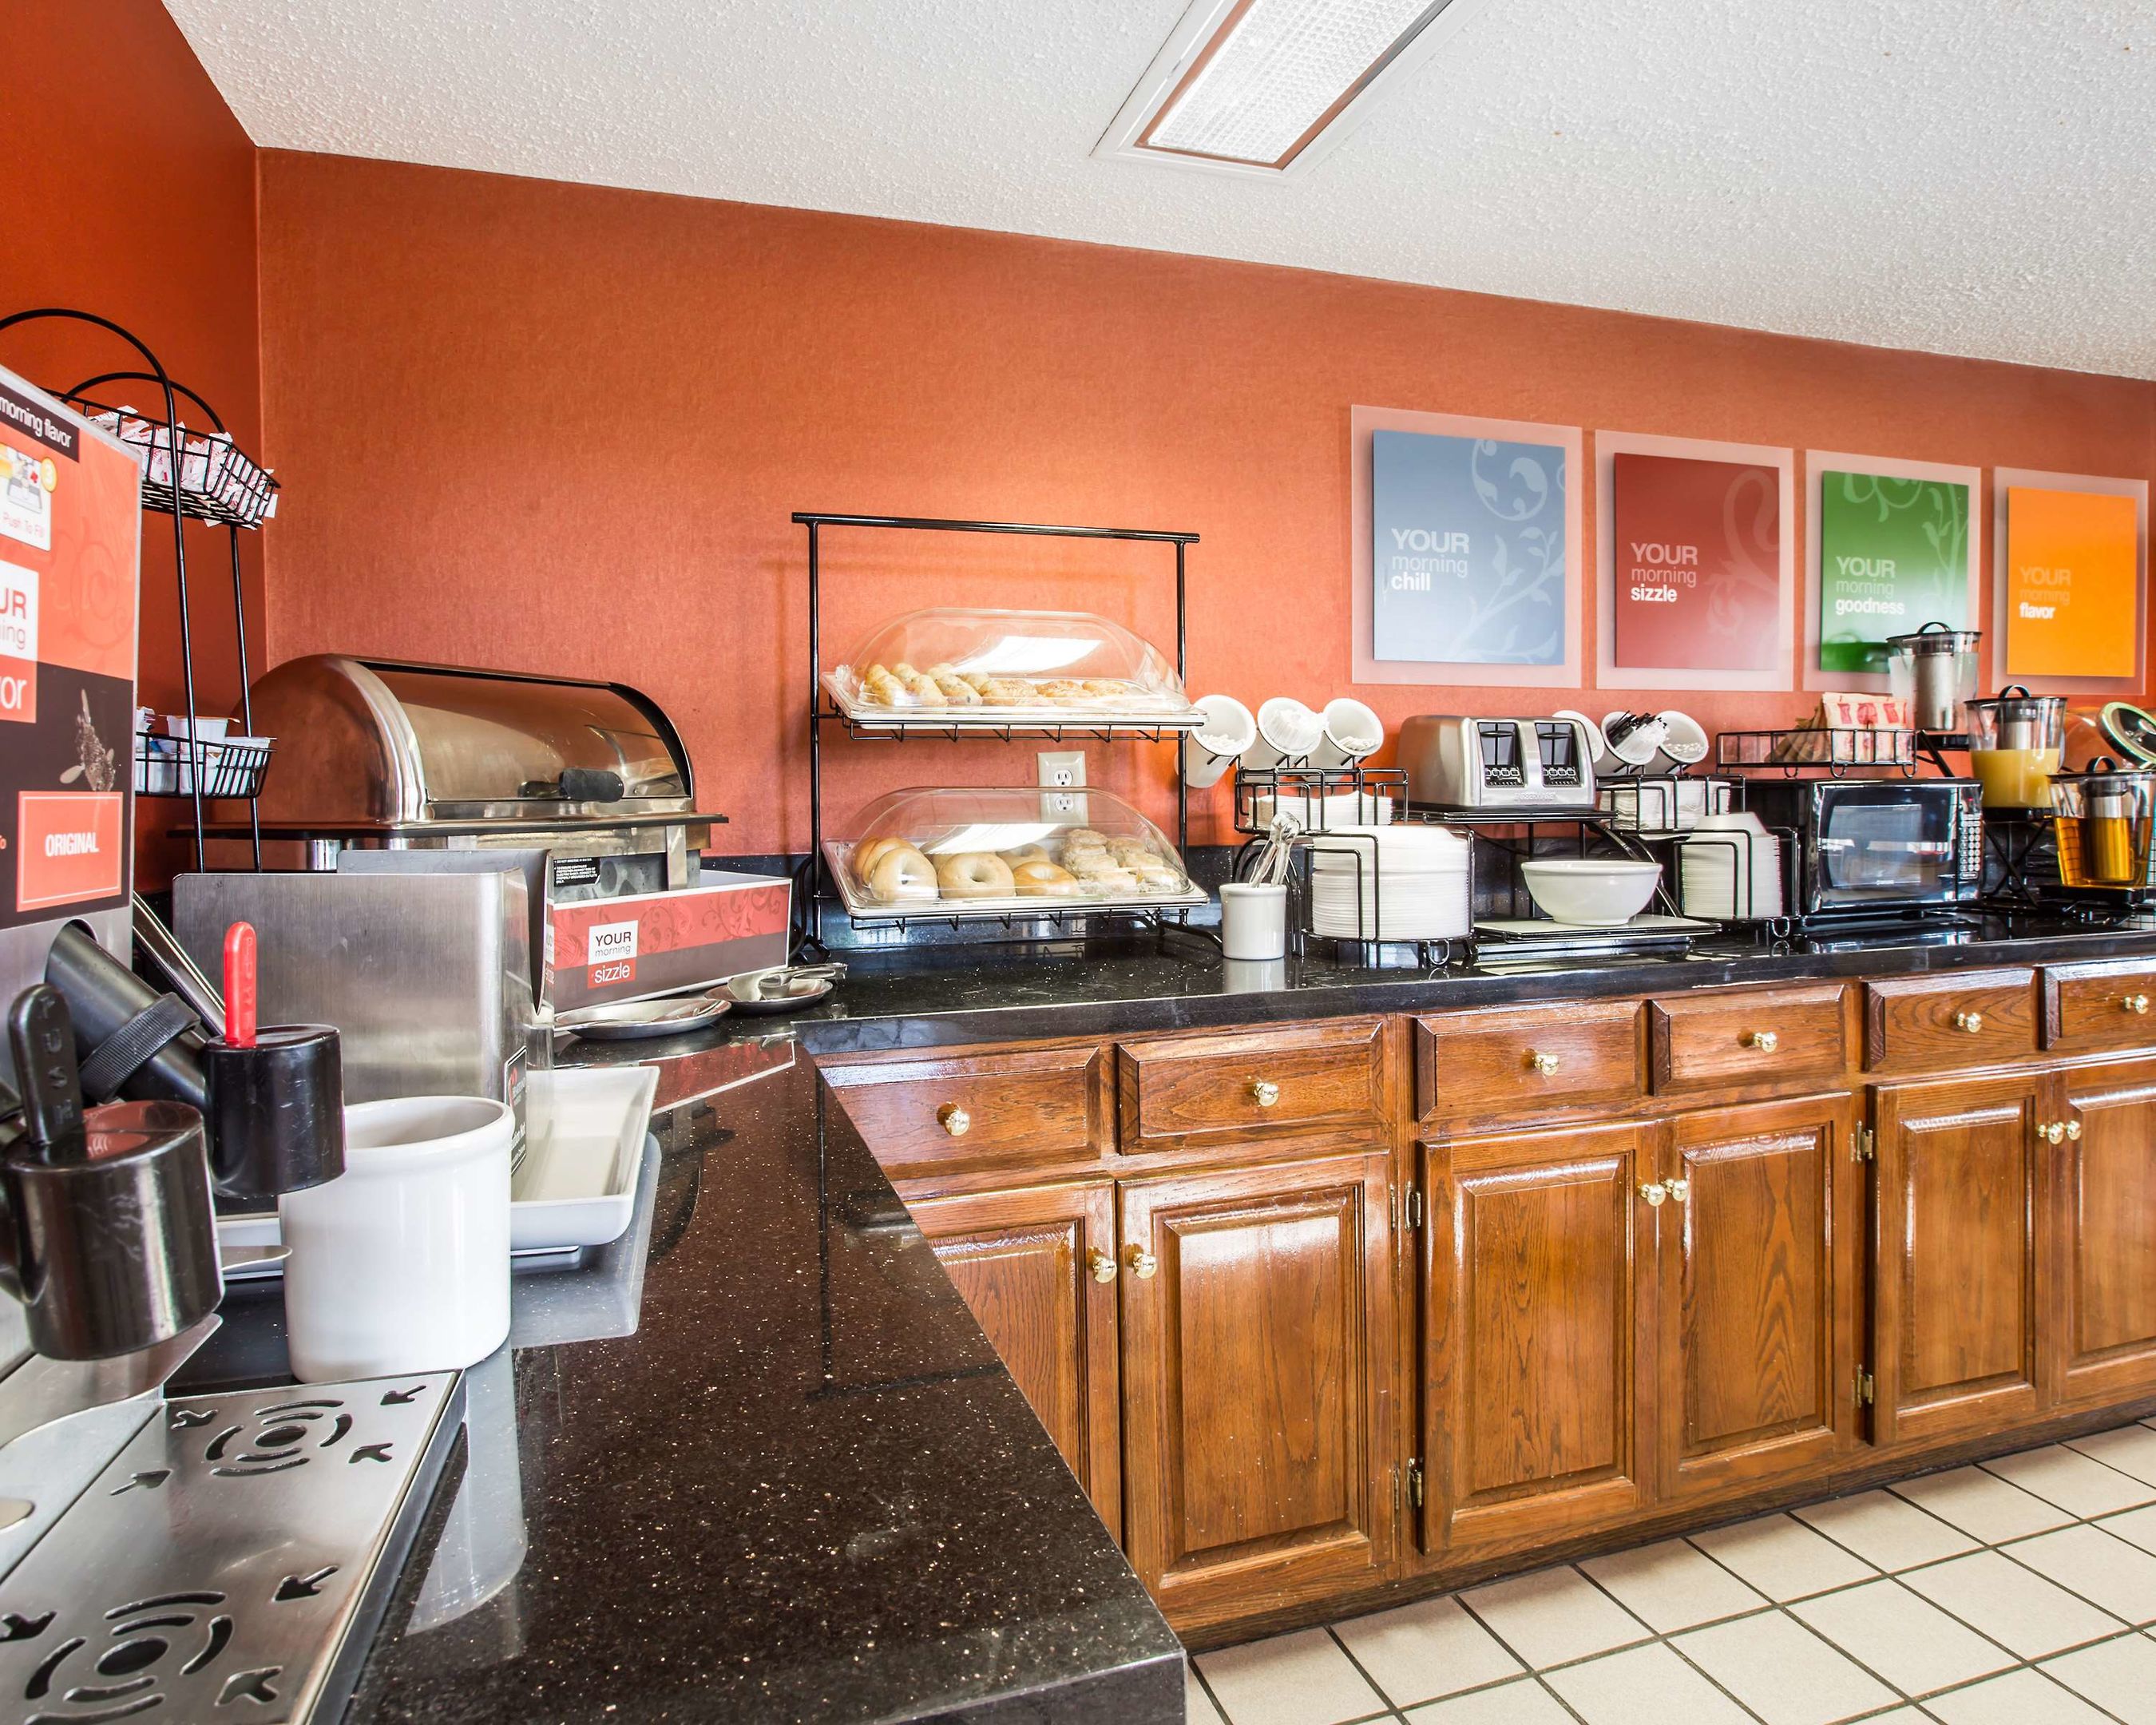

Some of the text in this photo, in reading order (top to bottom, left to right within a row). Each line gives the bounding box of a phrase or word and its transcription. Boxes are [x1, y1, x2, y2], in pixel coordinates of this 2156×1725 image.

[44, 418, 72, 448] flavor
[1391, 528, 1470, 554] YOUR
[1631, 542, 1698, 565] YOUR
[1392, 554, 1468, 578] morning
[1836, 556, 1896, 577] YOUR
[2019, 566, 2072, 586] YOUR
[1391, 572, 1431, 591] chill
[1631, 566, 1697, 588] morning
[1631, 583, 1678, 603] sizzle
[1837, 578, 1895, 599] morning
[2019, 588, 2071, 606] morning
[1836, 597, 1904, 615] goodness
[2019, 601, 2056, 619] flavor
[0, 620, 26, 650] ing
[0, 676, 27, 710] or
[45, 832, 100, 857] ORIGINAL
[595, 931, 632, 946] YOUR
[595, 946, 631, 957] morning
[594, 962, 631, 984] sizzle
